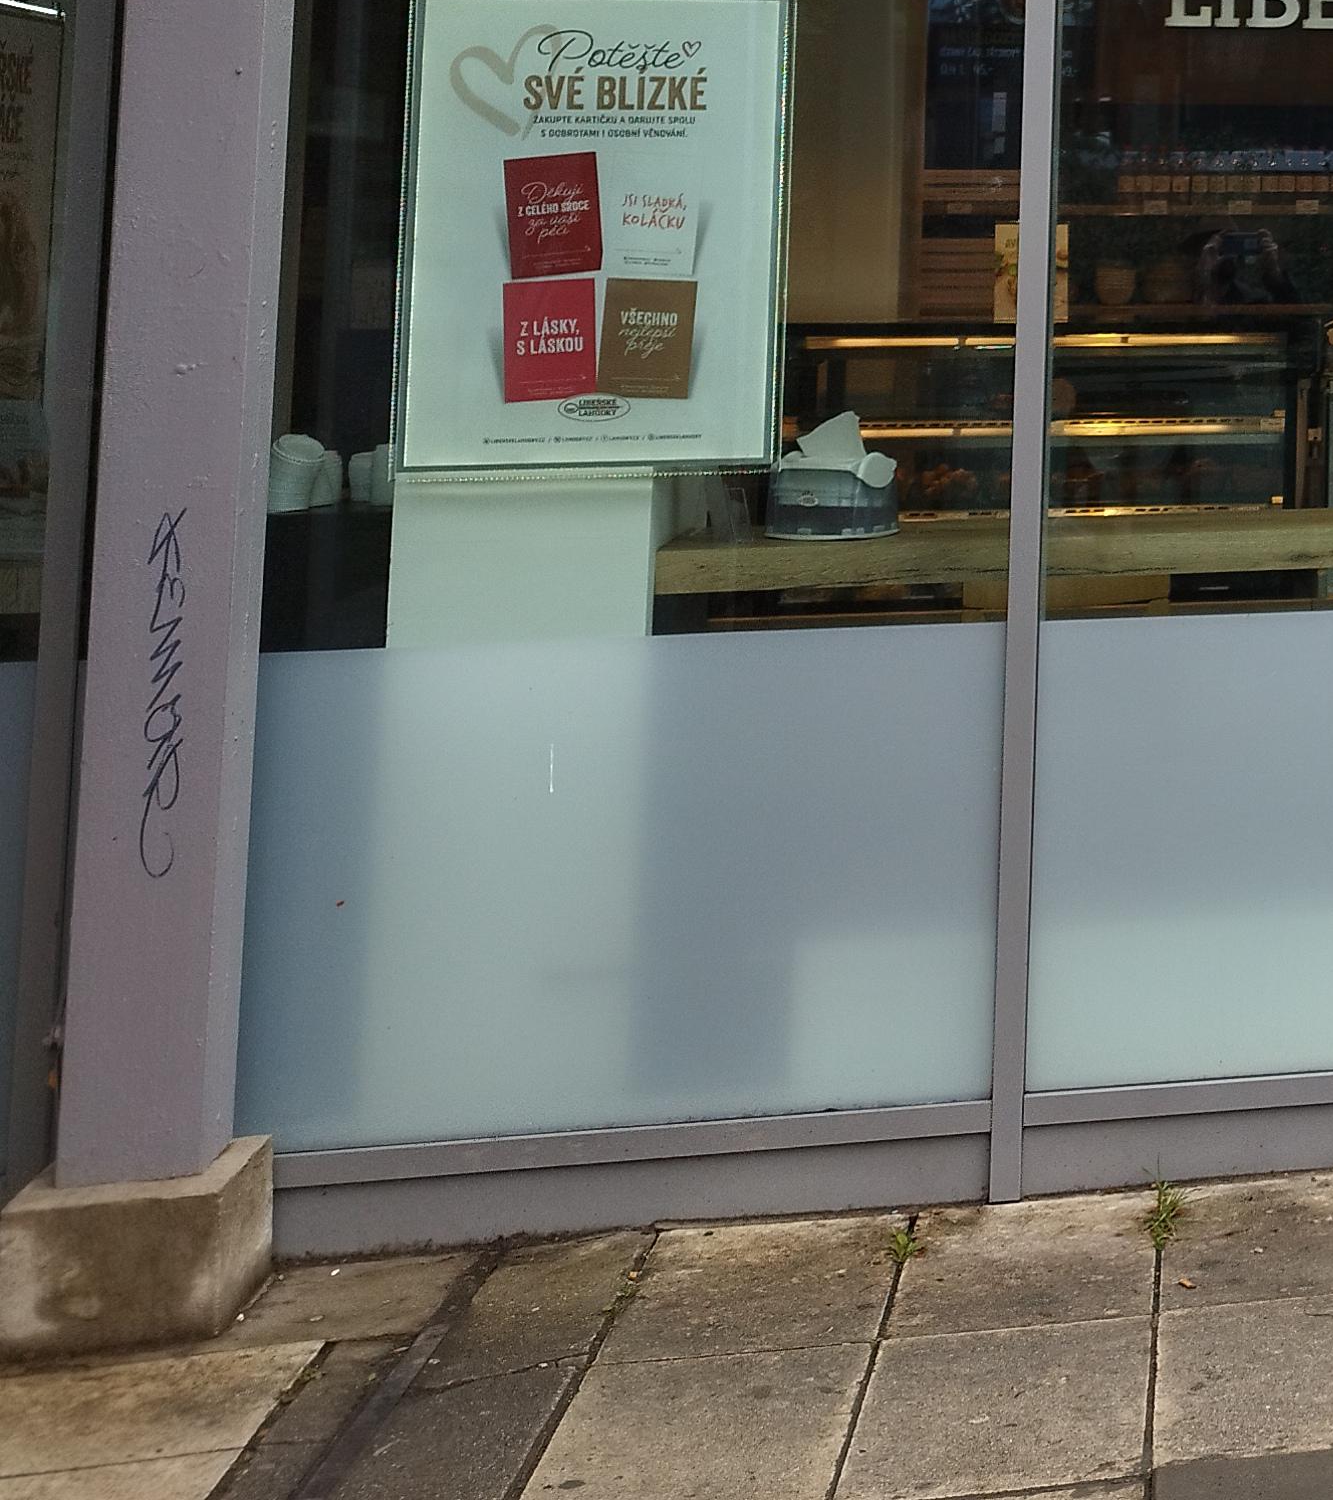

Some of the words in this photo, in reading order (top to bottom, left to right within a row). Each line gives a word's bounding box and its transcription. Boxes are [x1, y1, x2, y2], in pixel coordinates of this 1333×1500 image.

[538, 30, 685, 72] Potěšte
[523, 66, 585, 111] SVÉ
[596, 67, 708, 111] BLÍZKÉ
[619, 115, 626, 125] A
[621, 208, 686, 231] KOLÁČKU
[520, 321, 529, 337] Z
[533, 316, 580, 336] LÁSKY,
[620, 308, 678, 326] VŠECHNO
[516, 342, 526, 356] S
[530, 334, 584, 355] LÁSKOU
